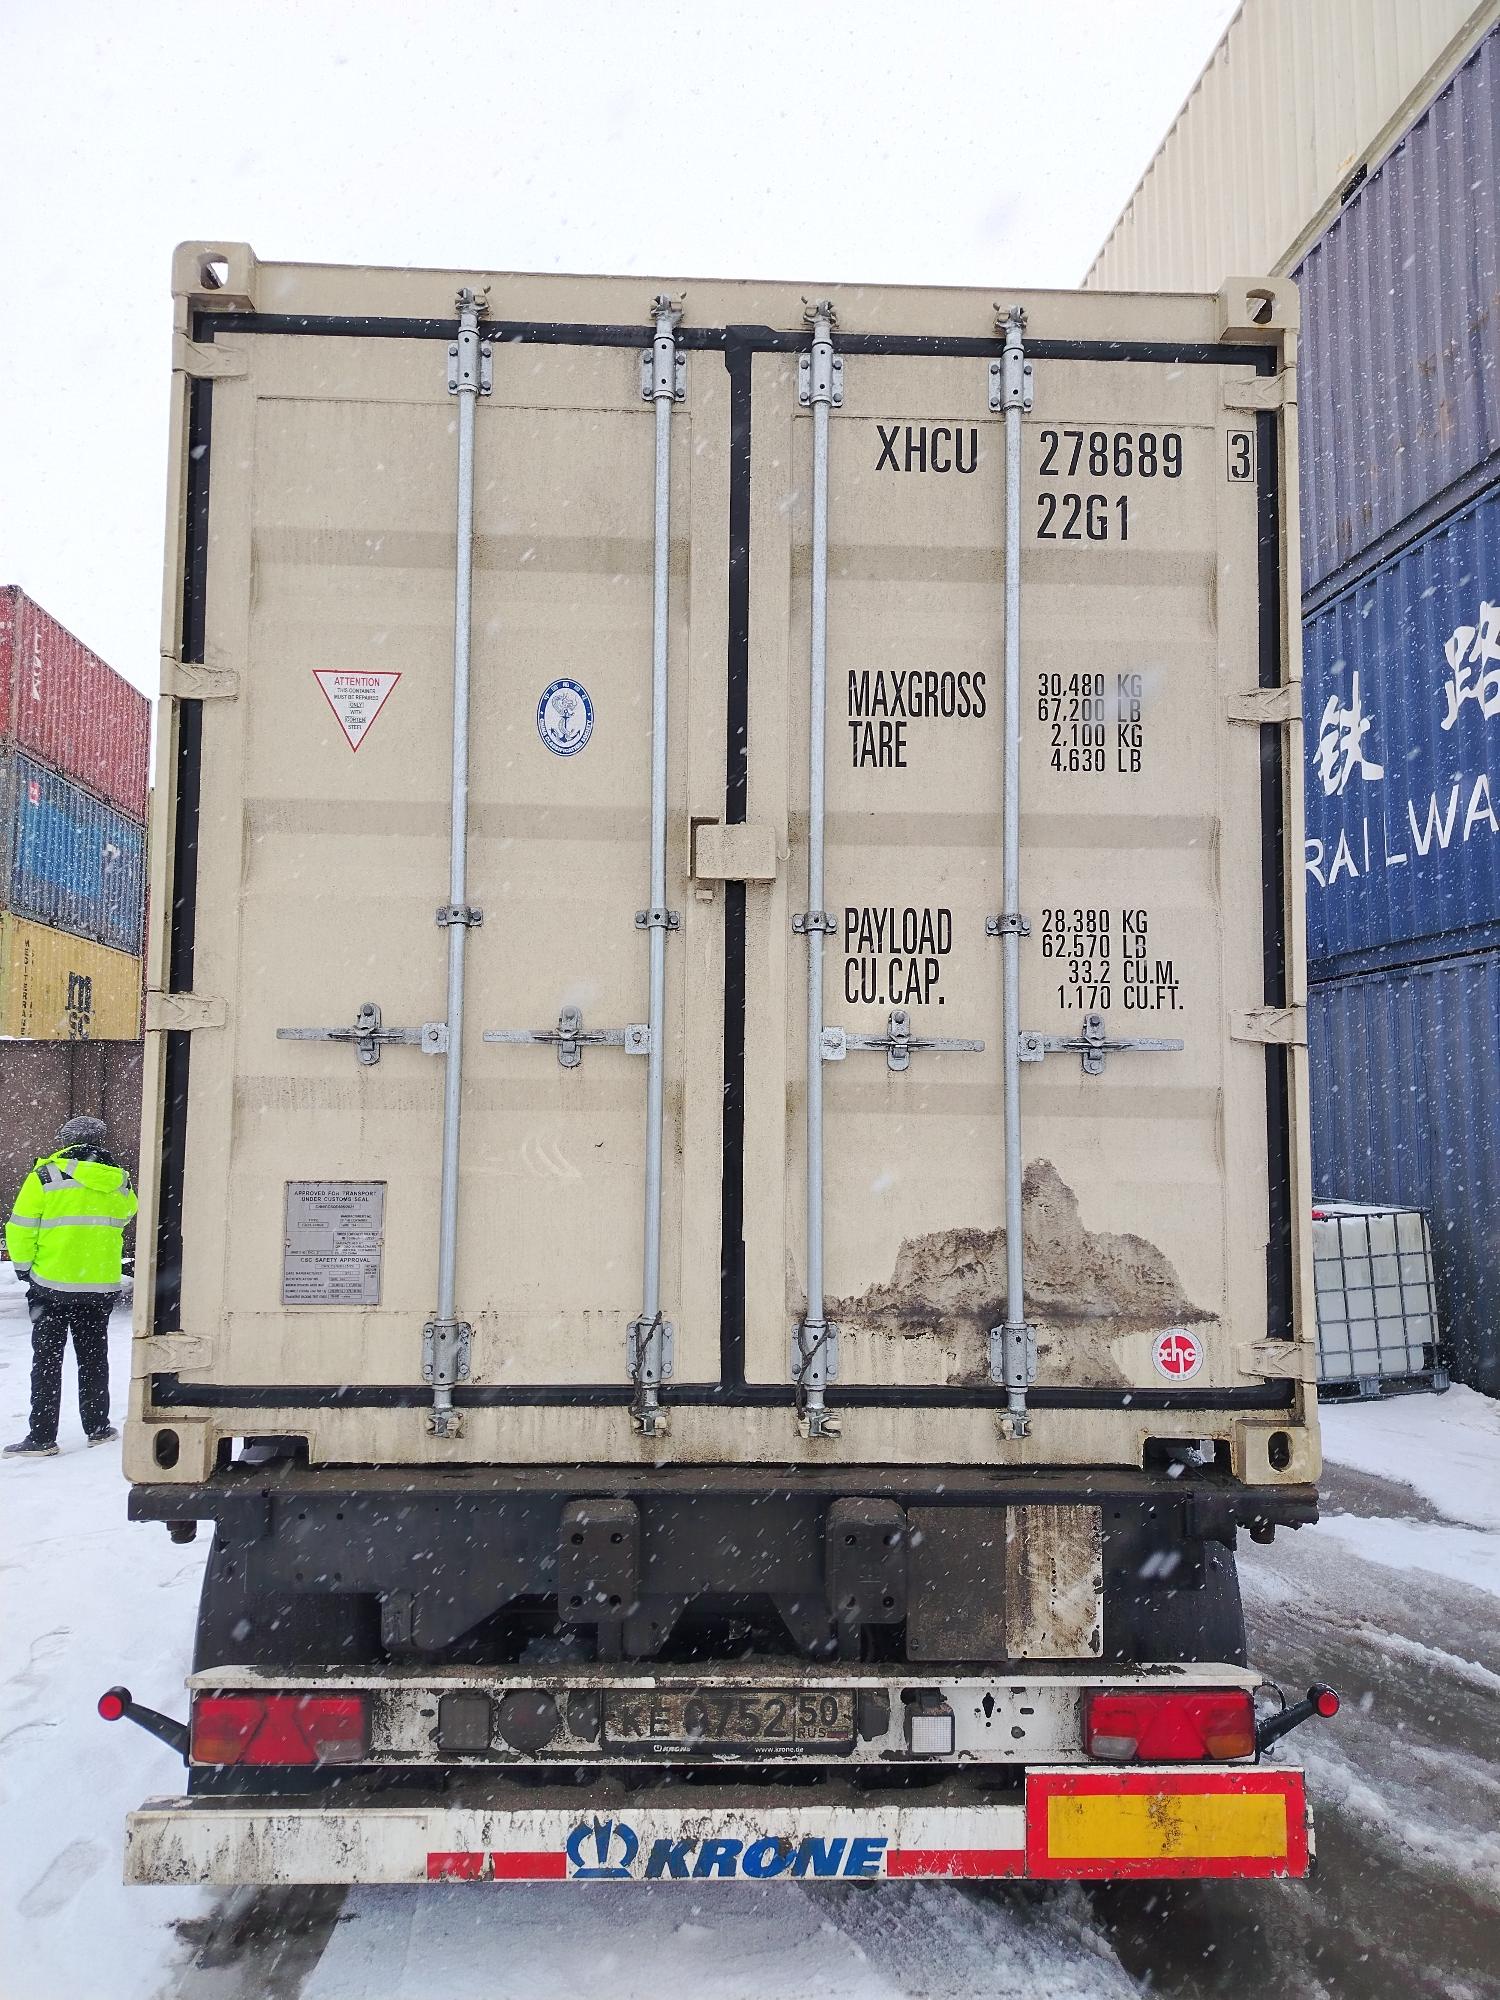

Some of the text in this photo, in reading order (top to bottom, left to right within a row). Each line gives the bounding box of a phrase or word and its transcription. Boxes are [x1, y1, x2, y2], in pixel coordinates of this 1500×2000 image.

[875, 425, 1251, 478] XHCU 278689 3
[1037, 493, 1128, 540] 22G1
[334, 676, 380, 687] ATTENTION
[848, 670, 1143, 718] MAXGROSS 30,480 KG
[1038, 698, 1141, 723] 67,200 LB
[848, 721, 1143, 768] TARE 2,100 KG
[1050, 748, 1141, 773] 4,630 LB
[844, 907, 1149, 955] PAYLOAD 28,380 KG
[1042, 934, 1147, 959] 62,570 LB
[844, 957, 946, 1005] CU.CAP.
[1068, 960, 1180, 985] 33.2 CU.M.
[1057, 984, 1184, 1010] 1,170 CU.FT.
[799, 1695, 839, 1727] 50
[797, 1727, 827, 1738] RUS
[643, 1838, 888, 1878] KRONE
